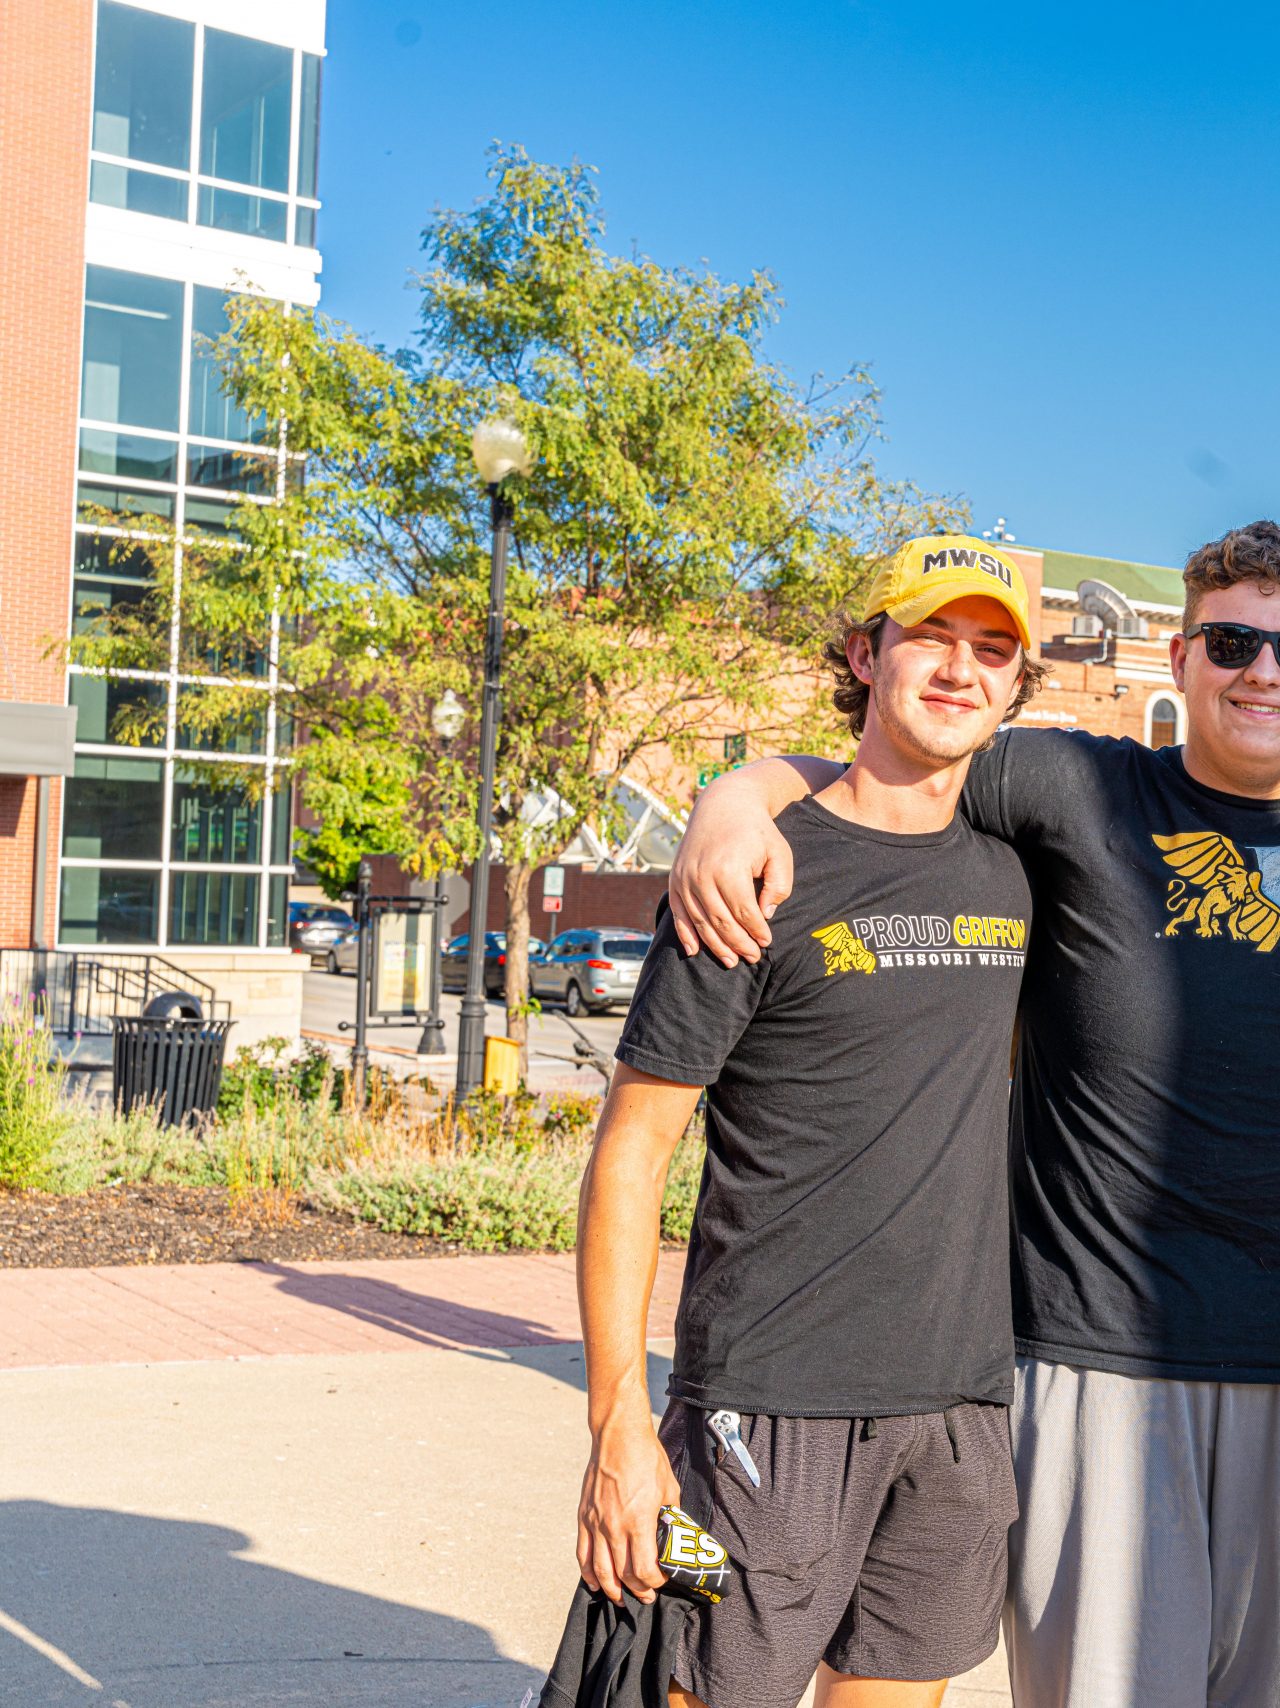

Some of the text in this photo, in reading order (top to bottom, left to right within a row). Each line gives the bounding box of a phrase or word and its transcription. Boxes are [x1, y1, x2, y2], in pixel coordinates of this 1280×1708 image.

[923, 548, 1012, 588] MWSU
[853, 915, 1026, 949] PROUD GRIFFON
[880, 953, 972, 968] MISSOURI
